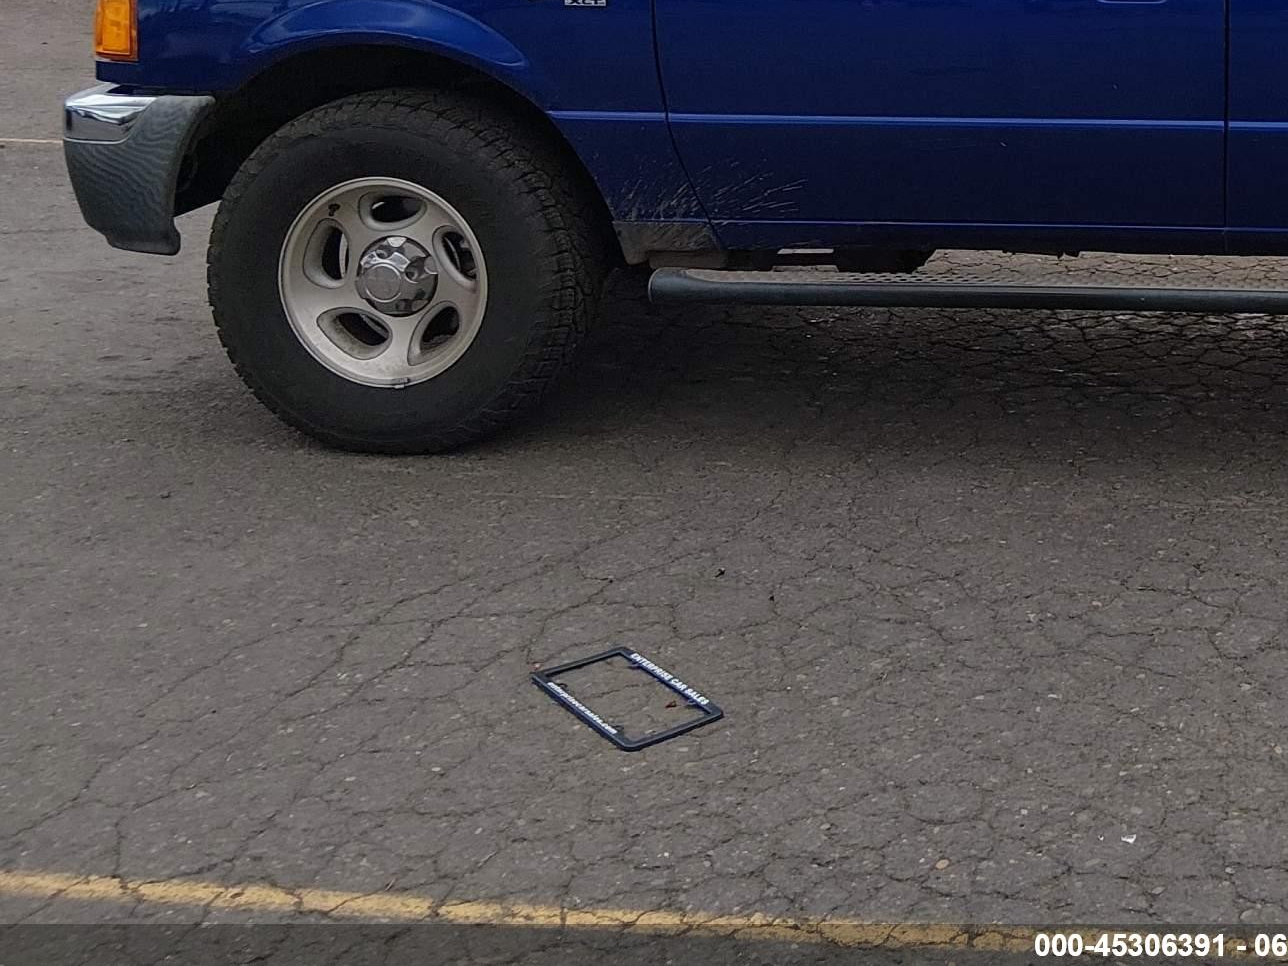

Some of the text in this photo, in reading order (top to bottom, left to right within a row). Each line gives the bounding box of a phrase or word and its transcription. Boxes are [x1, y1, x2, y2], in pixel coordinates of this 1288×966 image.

[631, 653, 710, 705] ENTERPRISE CAR SALES
